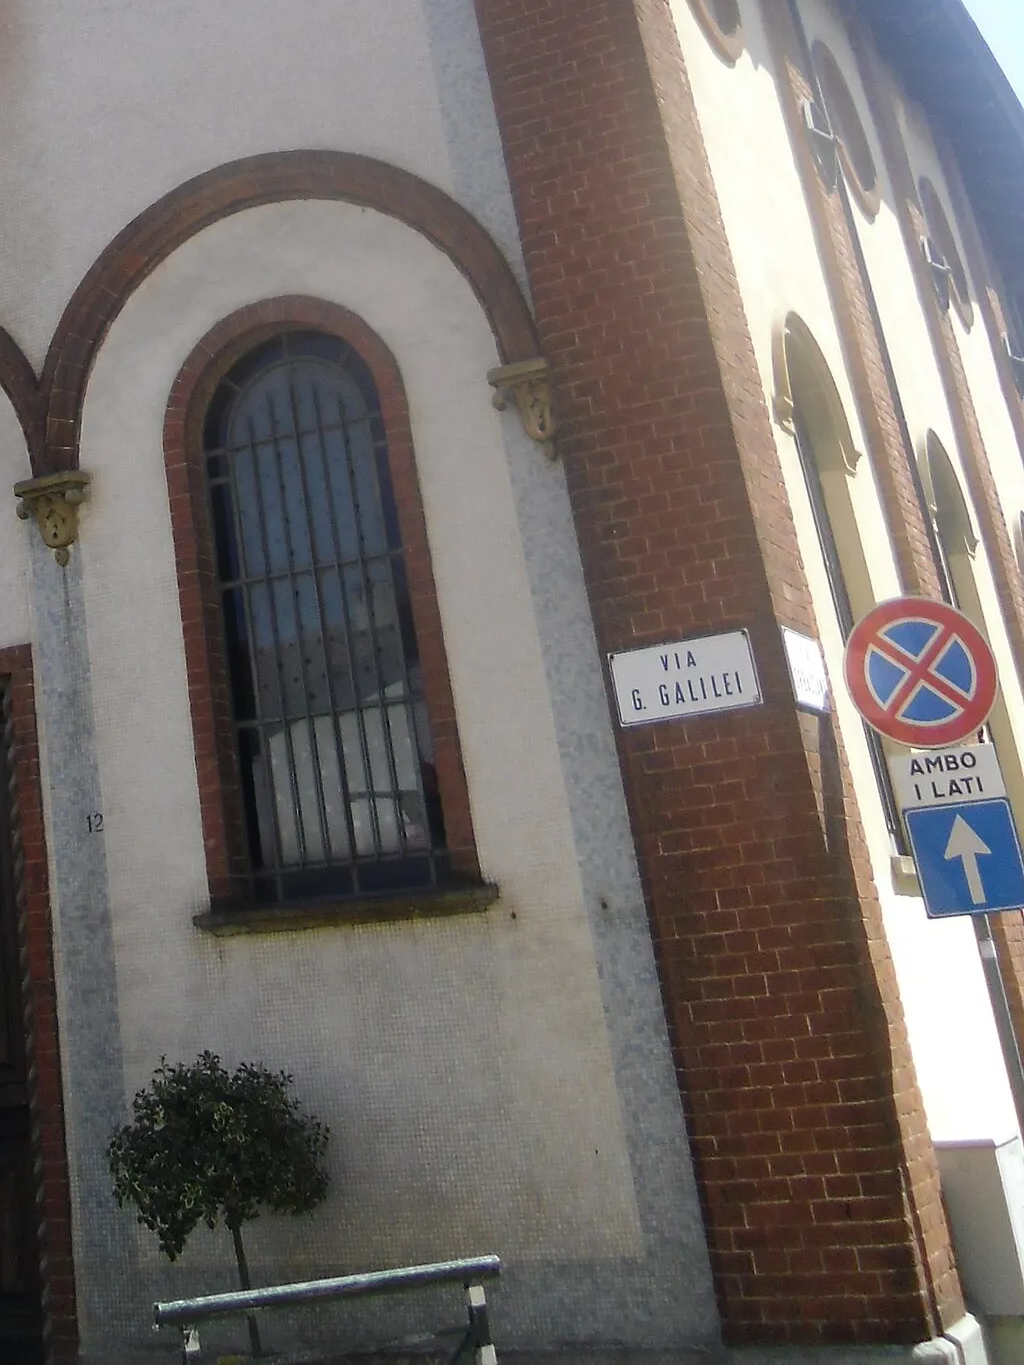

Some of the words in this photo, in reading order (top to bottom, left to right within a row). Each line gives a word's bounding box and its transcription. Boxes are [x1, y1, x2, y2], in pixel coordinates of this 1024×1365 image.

[660, 650, 696, 671] VIA
[631, 689, 647, 711] G.
[659, 671, 742, 706] GALILEI
[910, 752, 976, 776] AMBO
[914, 784, 922, 800] I
[931, 776, 984, 798] LATI
[86, 813, 104, 833] 12
